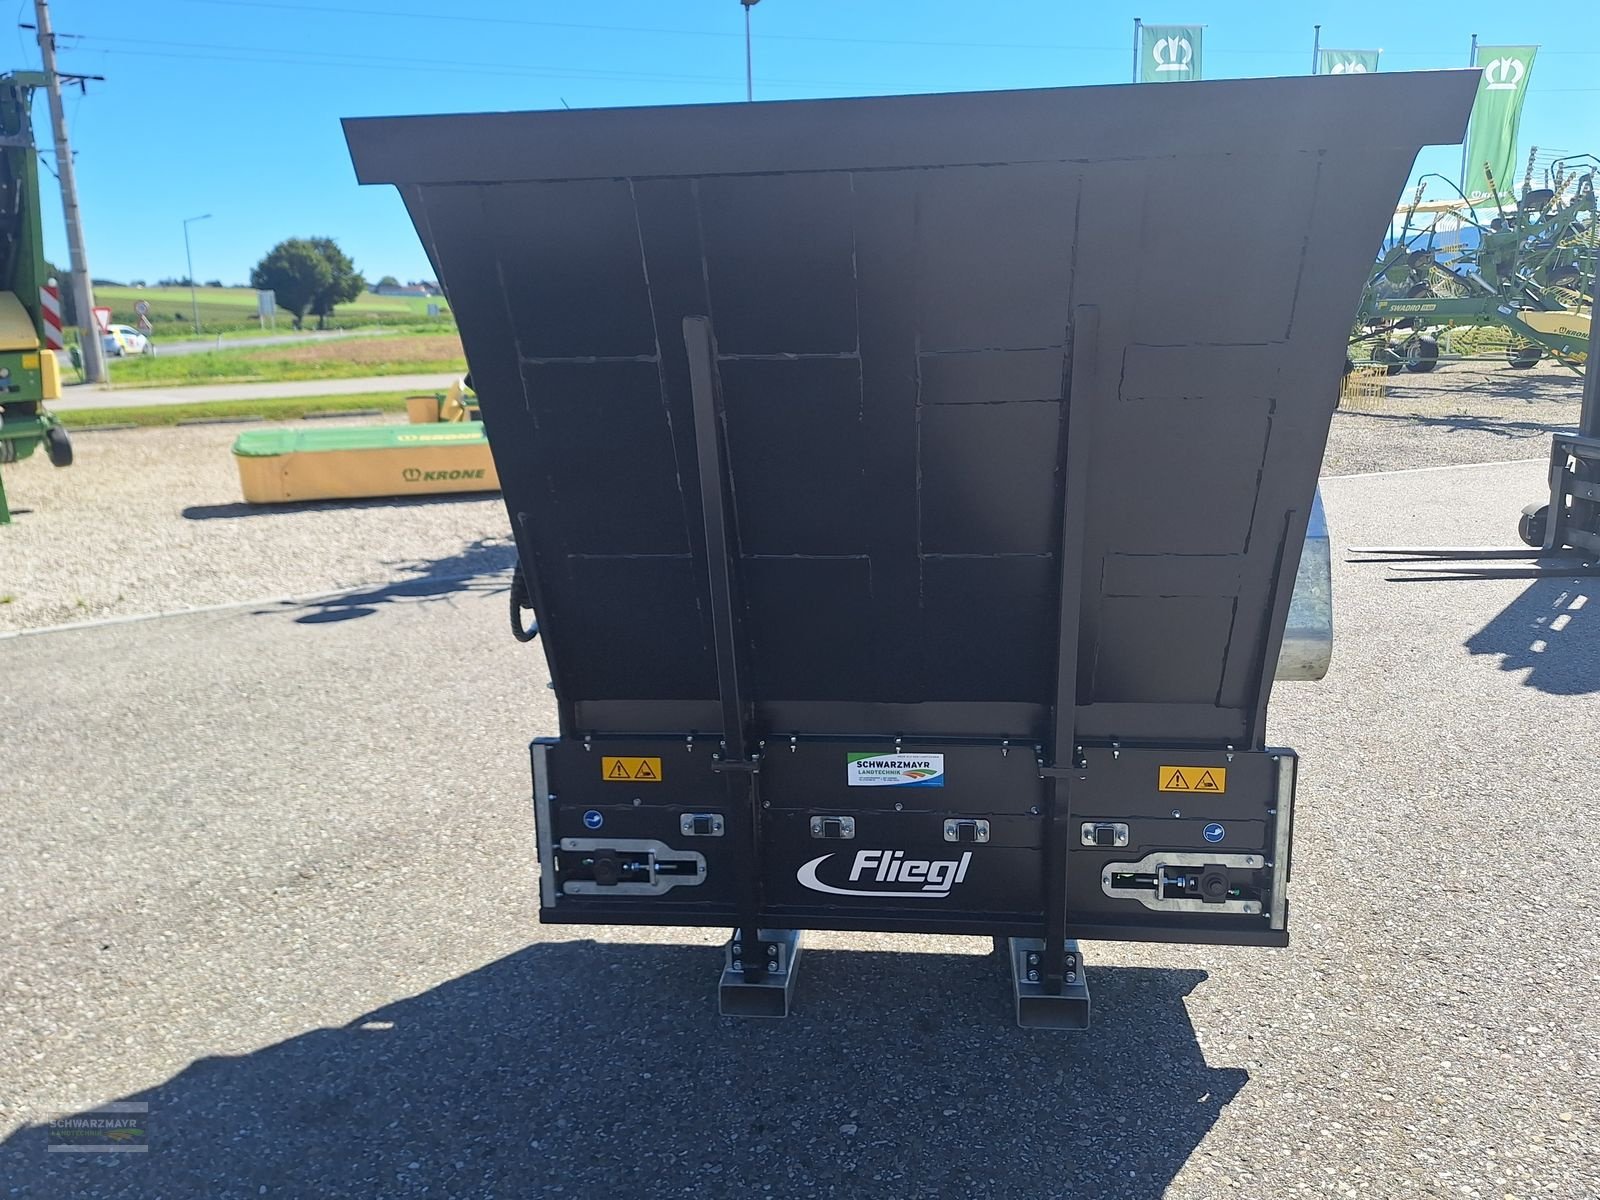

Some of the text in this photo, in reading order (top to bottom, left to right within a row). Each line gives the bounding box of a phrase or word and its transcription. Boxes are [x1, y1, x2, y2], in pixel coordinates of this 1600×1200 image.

[1389, 304, 1421, 312] SWADRO
[1565, 329, 1589, 338] KRON
[423, 469, 486, 480] KRONE
[856, 760, 930, 769] SCHWARZMAYR
[848, 850, 973, 891] Fliegl
